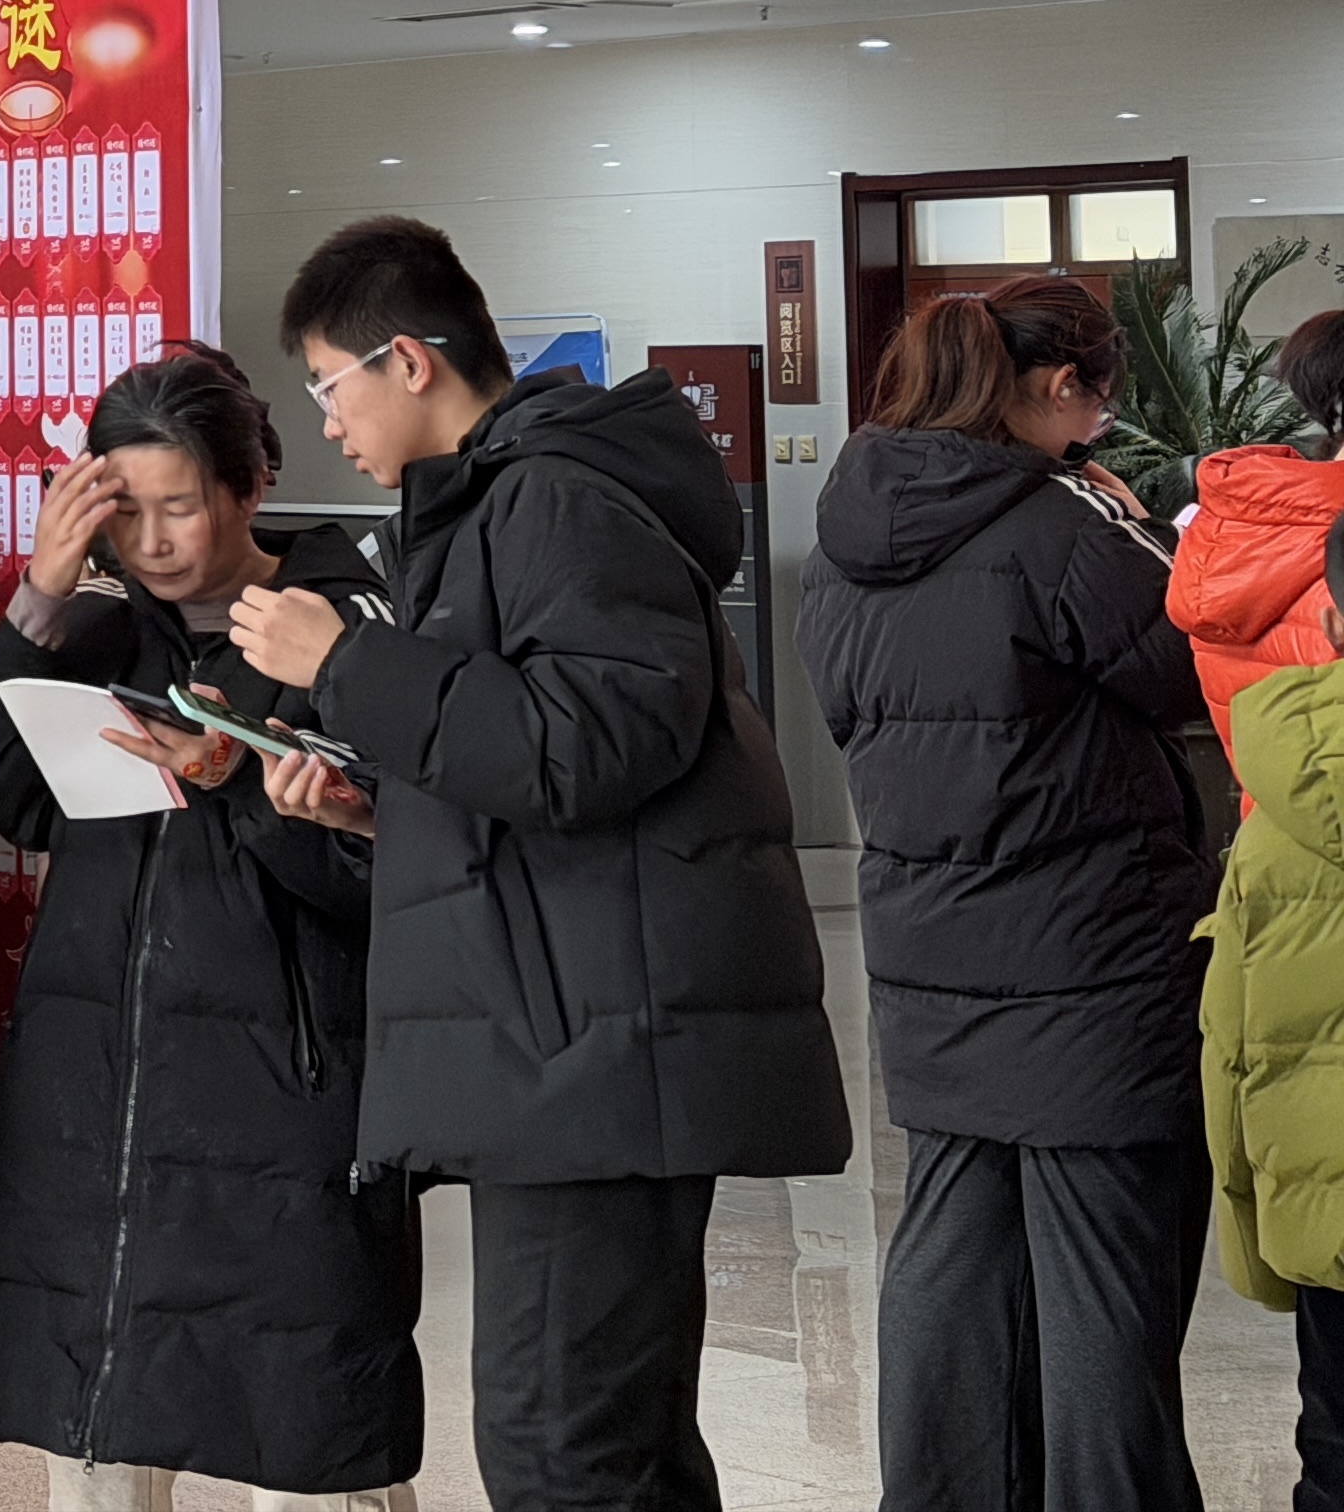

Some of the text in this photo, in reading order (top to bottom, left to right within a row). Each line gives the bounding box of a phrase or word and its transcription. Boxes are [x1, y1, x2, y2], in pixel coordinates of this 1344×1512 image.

[780, 302, 795, 385] 阅览区入口
